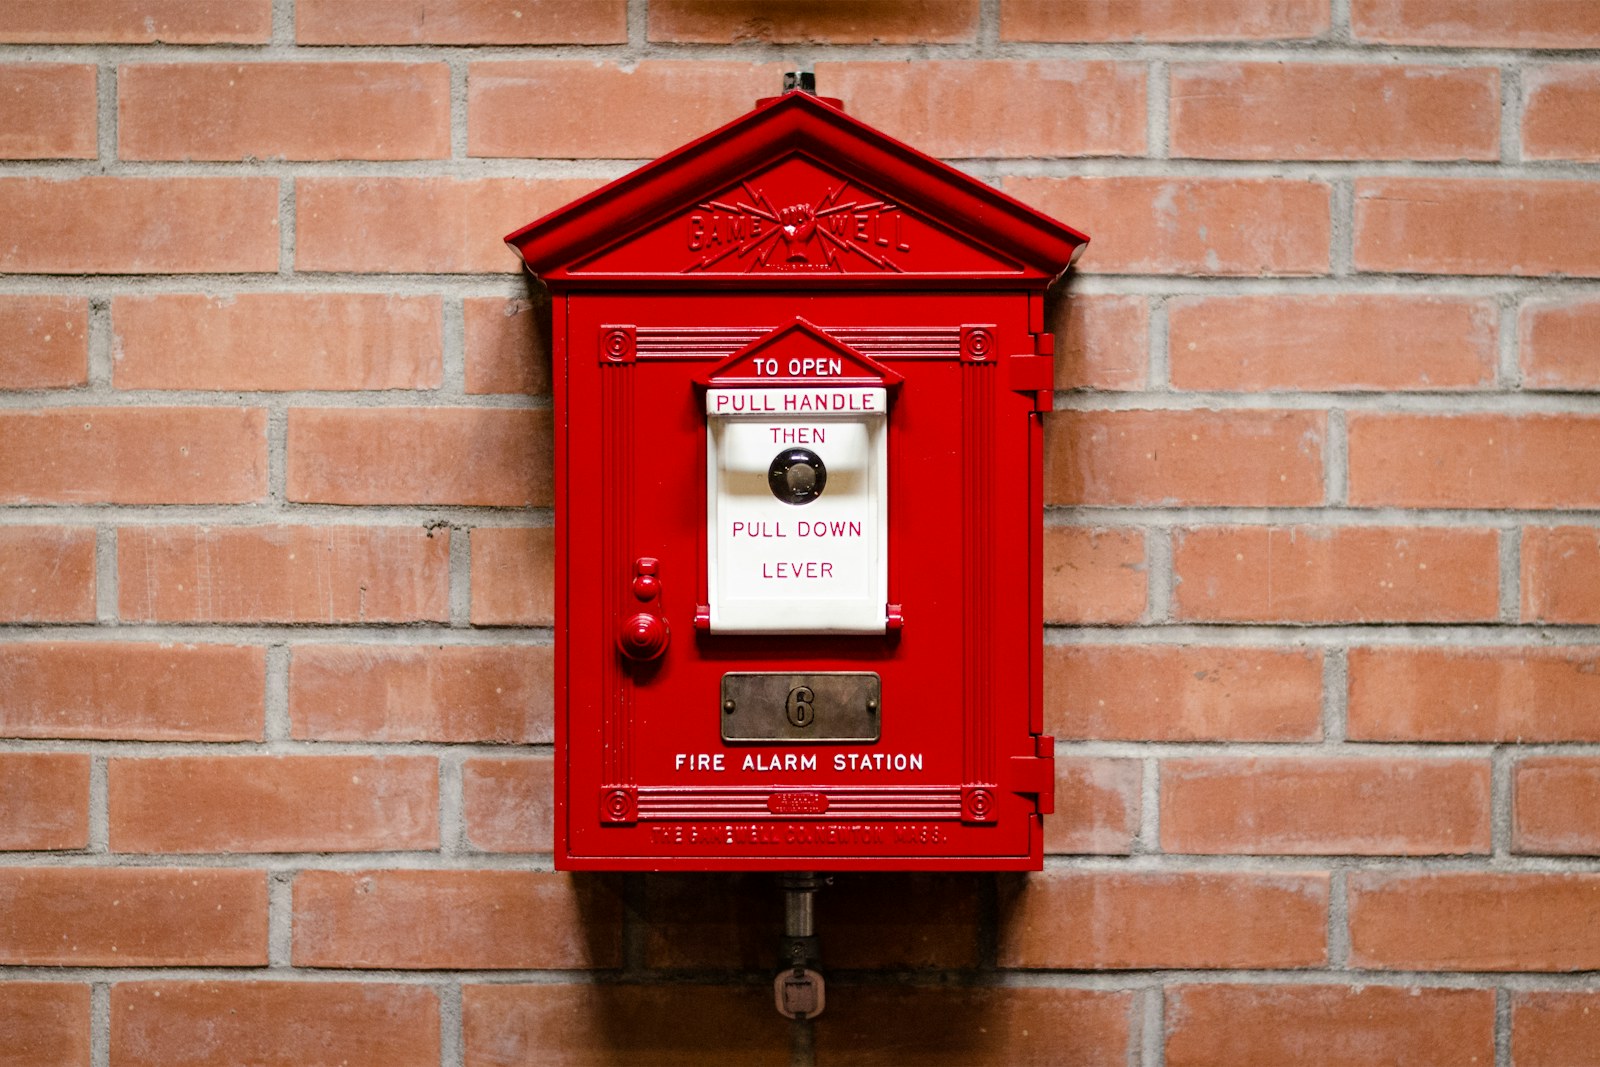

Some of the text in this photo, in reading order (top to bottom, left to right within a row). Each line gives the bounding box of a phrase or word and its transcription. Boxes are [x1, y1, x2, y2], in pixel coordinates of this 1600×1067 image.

[687, 214, 911, 252] GAME WELL
[753, 358, 842, 376] TO OPEN
[717, 393, 875, 411] PULL HANDLE
[769, 428, 825, 444] THEN
[732, 521, 862, 537] PULL DOWN
[763, 562, 834, 578] LEVER
[785, 685, 815, 728] 6
[675, 753, 924, 771] FIRE ALARM STATION
[651, 826, 683, 844] THE
